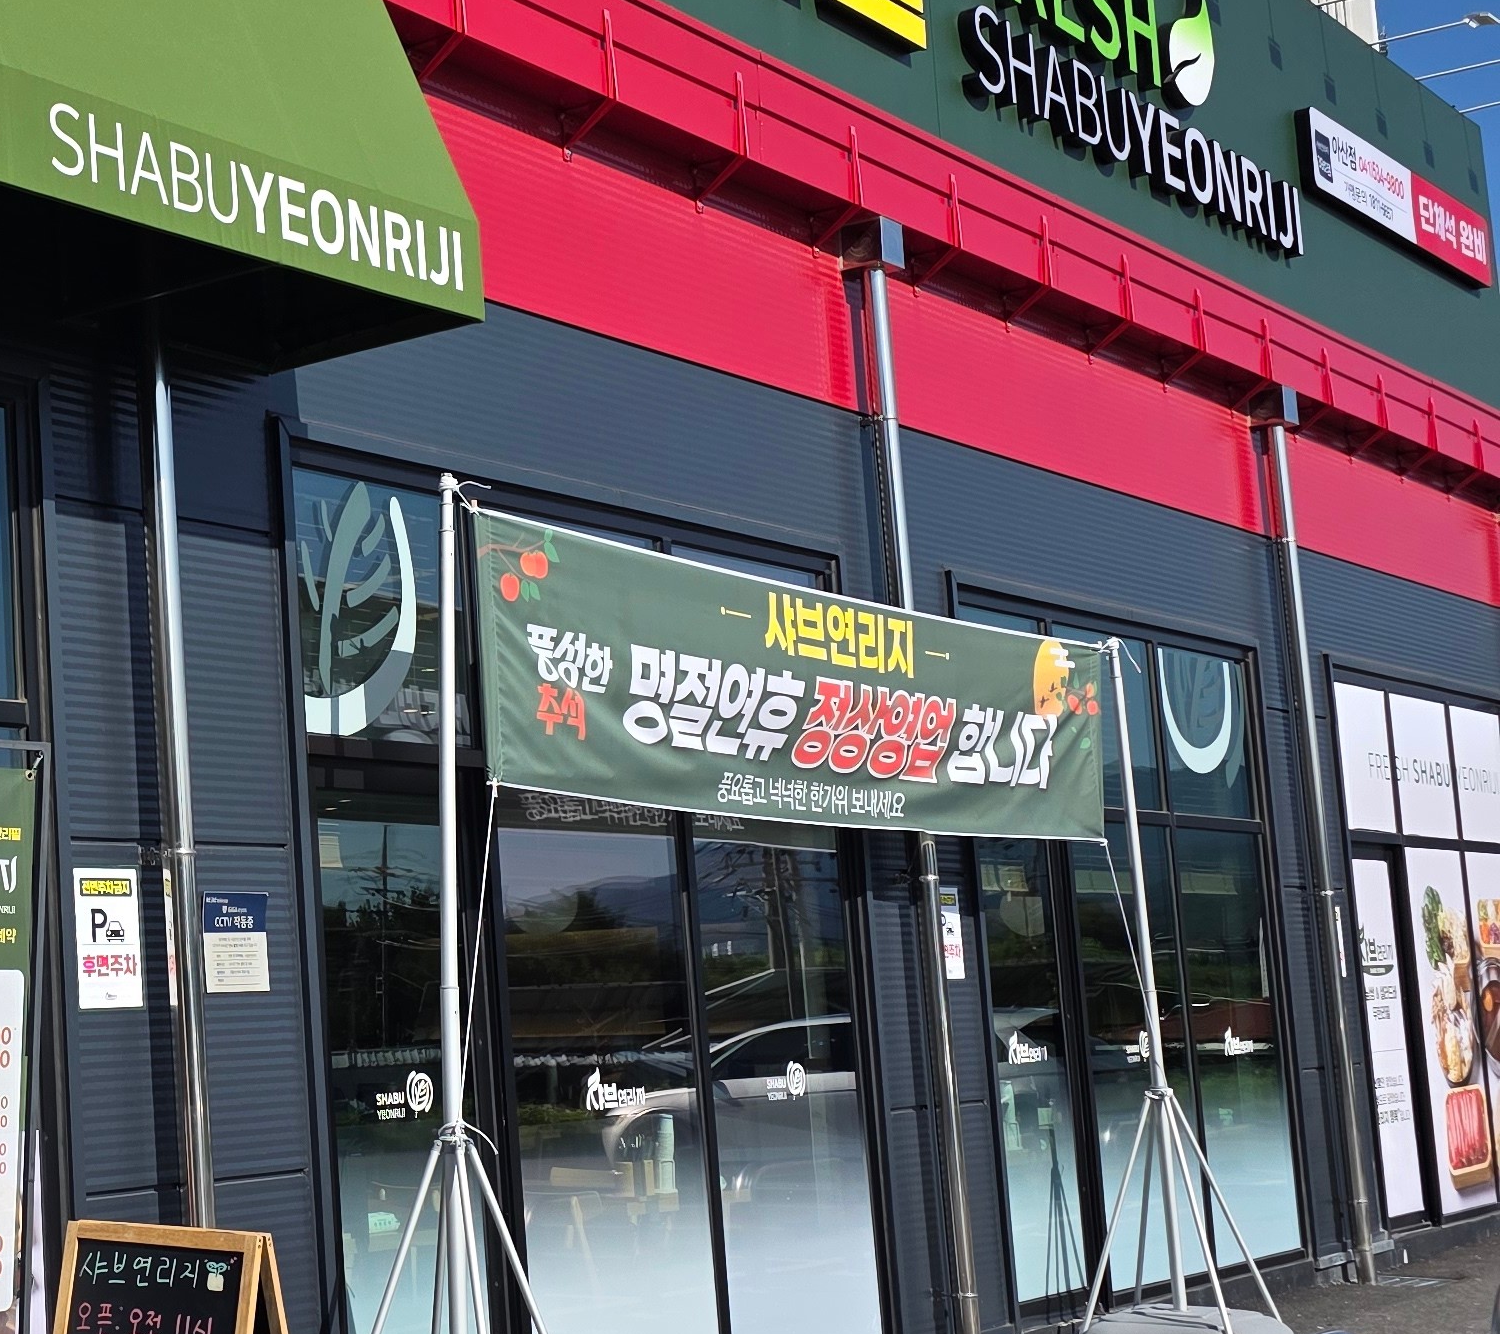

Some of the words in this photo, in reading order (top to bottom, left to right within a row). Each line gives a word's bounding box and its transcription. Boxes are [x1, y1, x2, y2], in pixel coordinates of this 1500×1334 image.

[973, 4, 1304, 256] SHABUYEONRIJI
[1332, 136, 1357, 171] 아산점
[49, 102, 464, 292] SHABUYEONRIJI
[1419, 194, 1457, 249] 단체석
[1459, 220, 1486, 265] 완비
[765, 591, 916, 679] 샤브연리지
[527, 623, 614, 694] 풍성한
[622, 642, 806, 763] 명절연휴
[791, 674, 958, 784] 정상영업
[947, 703, 1060, 790] 합니다
[536, 682, 587, 741] 추석
[1413, 758, 1450, 787] SHABU
[717, 771, 767, 805] 풍요롭고
[769, 777, 807, 810] 넉넉한
[810, 782, 849, 815] 한가위
[851, 788, 906, 819] 보내세요
[91, 908, 107, 942] P
[214, 916, 232, 927] CCTV
[82, 953, 138, 978] 후면주차
[376, 1091, 405, 1106] SHABU
[79, 1250, 200, 1289] 샤브연리지
